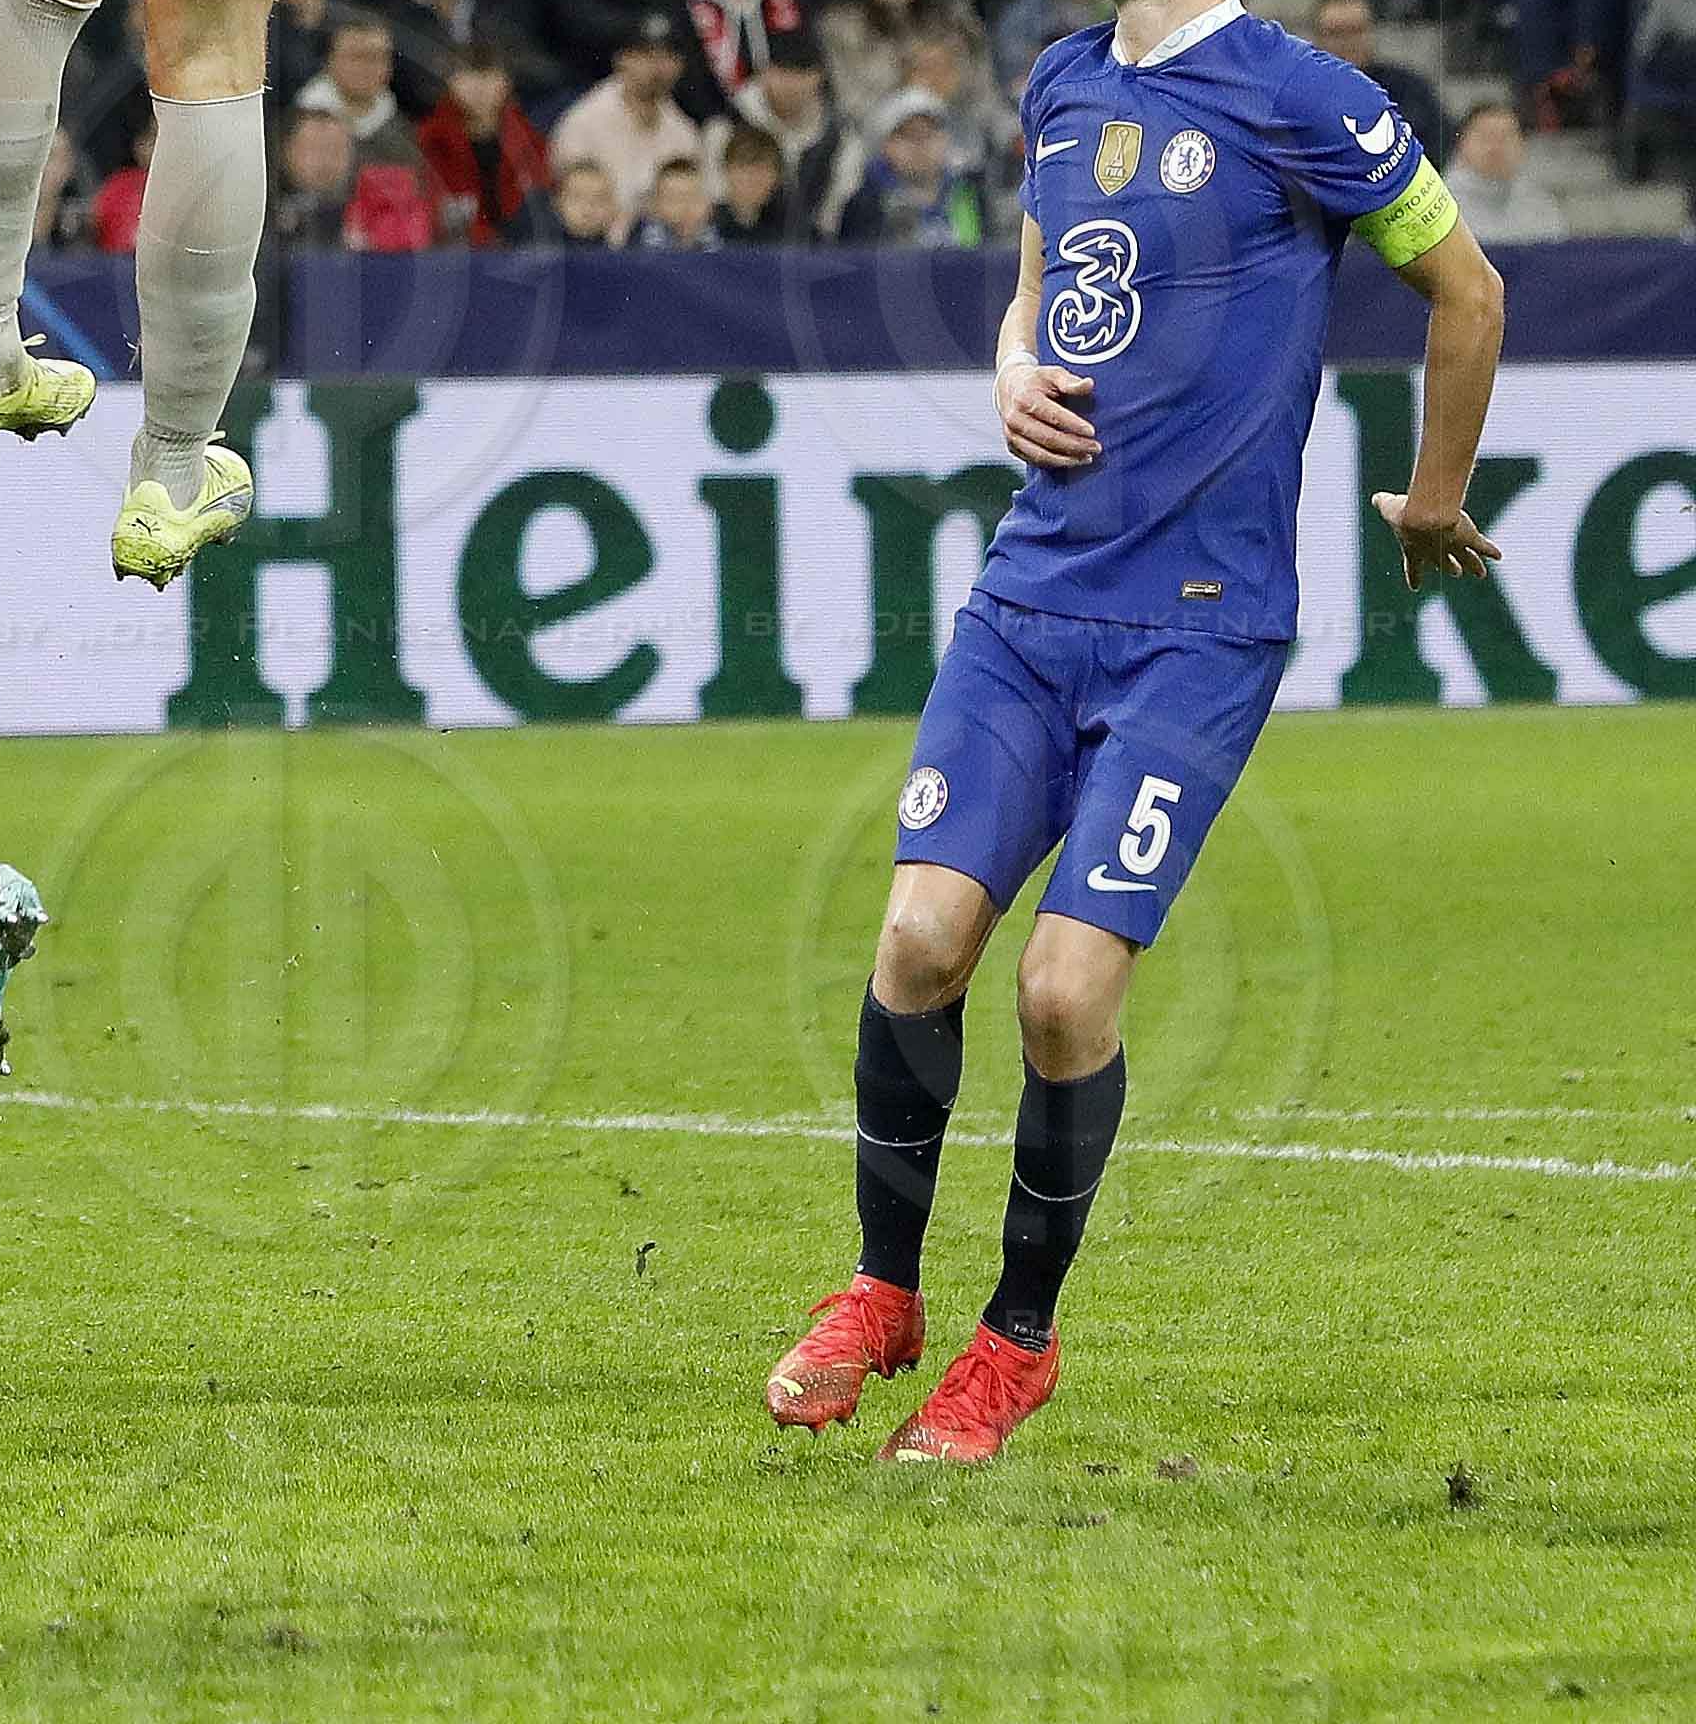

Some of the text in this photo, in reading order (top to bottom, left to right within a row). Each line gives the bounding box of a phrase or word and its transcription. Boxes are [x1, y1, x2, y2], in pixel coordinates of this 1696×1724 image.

[1384, 208, 1405, 225] NO
[1407, 195, 1421, 212] TO
[166, 371, 1696, 729] Heinke
[1118, 774, 1182, 877] 5
